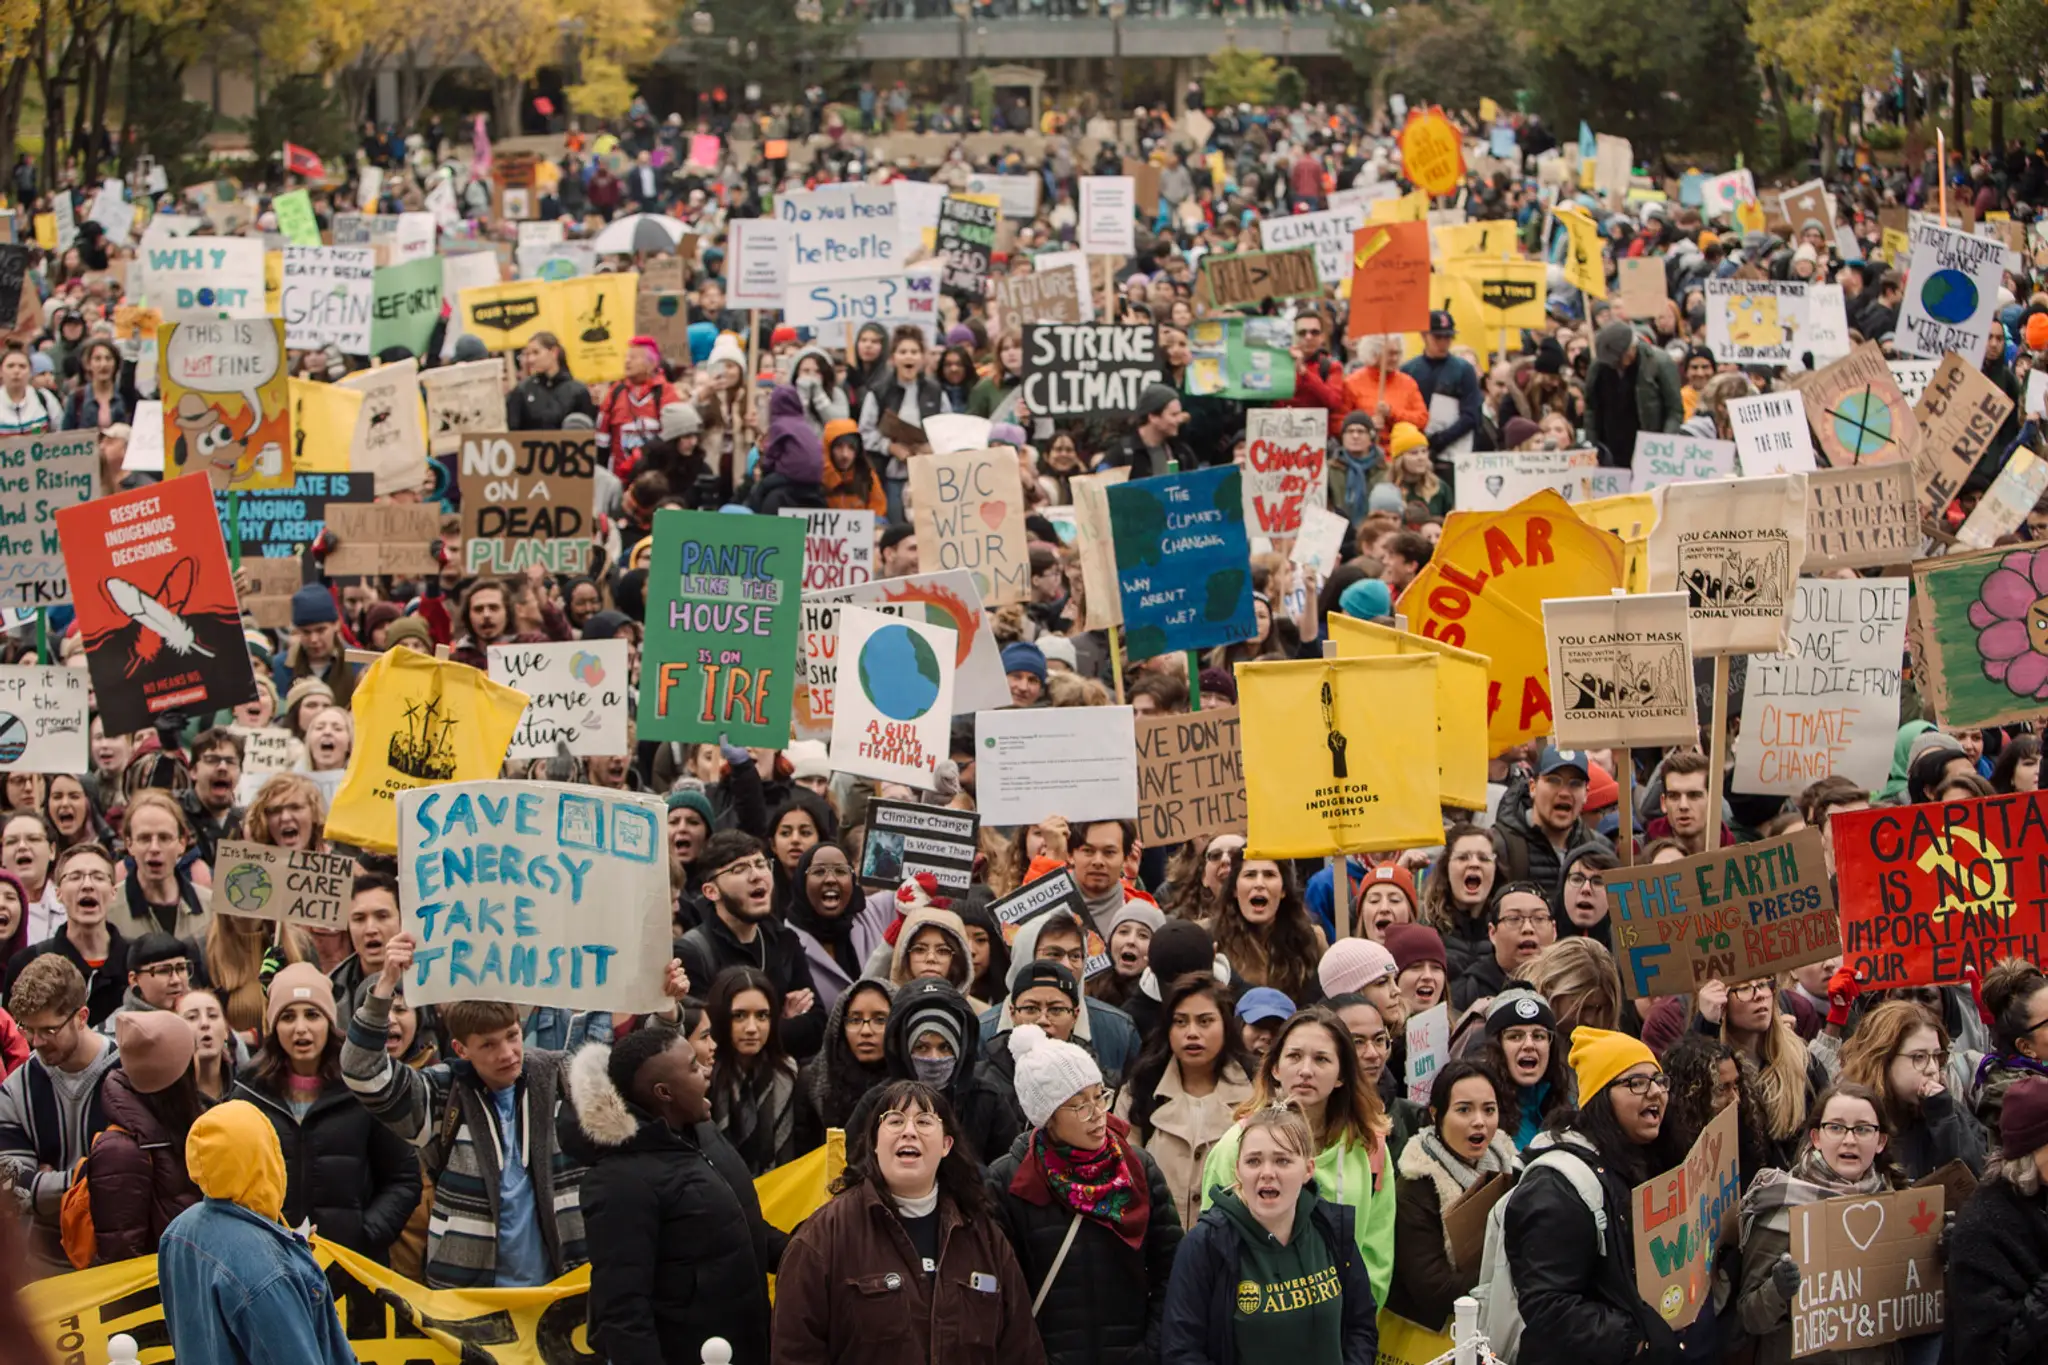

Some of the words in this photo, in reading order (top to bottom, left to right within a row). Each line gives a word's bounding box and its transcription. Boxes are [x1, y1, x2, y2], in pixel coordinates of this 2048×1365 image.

[783, 200, 812, 223] Do
[817, 201, 846, 221] you
[850, 194, 897, 219] hear
[1271, 217, 1358, 243] CLIMATE
[149, 248, 227, 270] WHY
[330, 249, 369, 263] NOT
[808, 280, 899, 321] Sing?
[1010, 270, 1078, 308] FUTURE
[186, 325, 222, 344] THIS
[234, 324, 252, 344] IS
[1031, 326, 1155, 366] STRIKE
[1907, 314, 1941, 342] WITH
[1943, 326, 1981, 352] DIET
[183, 356, 214, 377] NOT
[218, 356, 264, 376] FINE
[1738, 403, 1764, 424] SLEEP
[1765, 401, 1783, 419] NOW
[1784, 399, 1794, 416] IN
[1755, 434, 1774, 454] THE
[1775, 430, 1794, 451] FIRE
[1952, 391, 2008, 466] RISE
[30, 440, 93, 463] Oceans
[461, 439, 514, 477] NO
[515, 440, 595, 479] JOBS
[1643, 441, 1675, 458] and
[1684, 443, 1714, 461] she
[1649, 458, 1685, 478] said
[1693, 464, 1718, 480] ur
[37, 468, 92, 500] Rising
[331, 475, 350, 495] IS
[485, 479, 519, 502] ON
[527, 480, 552, 501] A
[1164, 485, 1190, 503] THE
[110, 496, 160, 526] RESPECT
[477, 506, 582, 538] DEAD
[932, 501, 976, 538] WE
[1252, 495, 1304, 532] WE
[105, 515, 177, 548] INDIGENOUS
[847, 520, 861, 532] IS
[1677, 531, 1701, 545] YOU
[1702, 529, 1756, 542] CANNOT
[1757, 527, 1789, 540] MASK
[111, 537, 178, 568] DECISIONS.
[466, 537, 592, 575] PLANET
[853, 547, 869, 561] THE
[940, 535, 1008, 571] OUR
[1162, 532, 1226, 556] CHANGING
[680, 540, 779, 581] PANIC
[16, 579, 67, 602] TKU
[684, 575, 728, 596] LIKE
[743, 581, 778, 600] THE
[1122, 576, 1151, 595] WHY
[1423, 517, 1556, 649] SOLAR
[669, 600, 773, 636] HOUSE
[1165, 608, 1197, 626] WE?
[1860, 586, 1907, 622] DIE
[1558, 635, 1587, 646] YOU
[1588, 632, 1645, 645] CANNOT
[1646, 631, 1684, 643] MASK
[1859, 622, 1895, 645] OF
[504, 651, 553, 678] we
[698, 649, 712, 663] IS
[720, 650, 741, 664] ON
[1567, 650, 1593, 658] STAND
[1593, 649, 1616, 657] WITH
[41, 671, 54, 689] it
[66, 672, 80, 690] in
[655, 661, 772, 727] FIRE
[1810, 667, 1863, 697] DIE
[1862, 667, 1902, 698] FROM
[33, 693, 60, 711] the
[602, 690, 622, 708] a
[35, 715, 82, 738] ground
[1564, 708, 1625, 721] COLONIAL
[1627, 707, 1689, 719] VIOLENCE
[1759, 703, 1861, 749] CLIMATE
[866, 720, 880, 734] A
[885, 724, 918, 742] GIRL
[1177, 716, 1241, 755] DON'T
[859, 742, 924, 768] FIGHTING
[926, 754, 936, 773] 4
[1758, 747, 1847, 784] CHANGE
[372, 787, 395, 801] FOR
[1306, 794, 1379, 811] INDIGENOUS
[1315, 785, 1341, 798] RISE
[1344, 783, 1368, 794] FOR
[416, 792, 545, 849] SAVE
[881, 807, 925, 826] Climate
[926, 815, 970, 832] Change
[1137, 799, 1186, 843] FOR
[1321, 806, 1365, 820] RIGHTS
[263, 851, 277, 863] to
[916, 839, 949, 856] Worse
[951, 844, 972, 858] Than
[287, 850, 353, 878] LISTEN
[414, 842, 594, 905] ENERGY
[286, 872, 343, 898] CARE
[1607, 872, 1688, 921] THE
[1695, 842, 1799, 907] EARTH
[1878, 869, 1913, 915] IS
[1935, 856, 2024, 908] NOT
[287, 896, 341, 922] ACT!
[1000, 899, 1027, 921] OUR
[1027, 880, 1069, 910] HOUSE
[415, 894, 542, 943] TAKE
[1617, 923, 1640, 950] IS
[1747, 884, 1822, 926] PRESS
[1847, 900, 2015, 953] IMPORTANT
[1695, 931, 1731, 954] TO
[1742, 908, 1840, 969] RESPECTS
[412, 938, 619, 990] TRANSIT
[1628, 942, 1671, 998] F
[1692, 951, 1737, 982] PAY
[1855, 953, 1909, 985] OUR
[1409, 1022, 1431, 1053] MAKE
[1413, 1053, 1436, 1078] EARTH
[1642, 1168, 1687, 1233] Lil
[1802, 1210, 1810, 1265] I
[1265, 1268, 1329, 1294] UNIVERSITY
[1798, 1266, 1862, 1312] CLEAN
[1905, 1258, 1921, 1291] A
[1877, 1289, 1945, 1335] FUTURE
